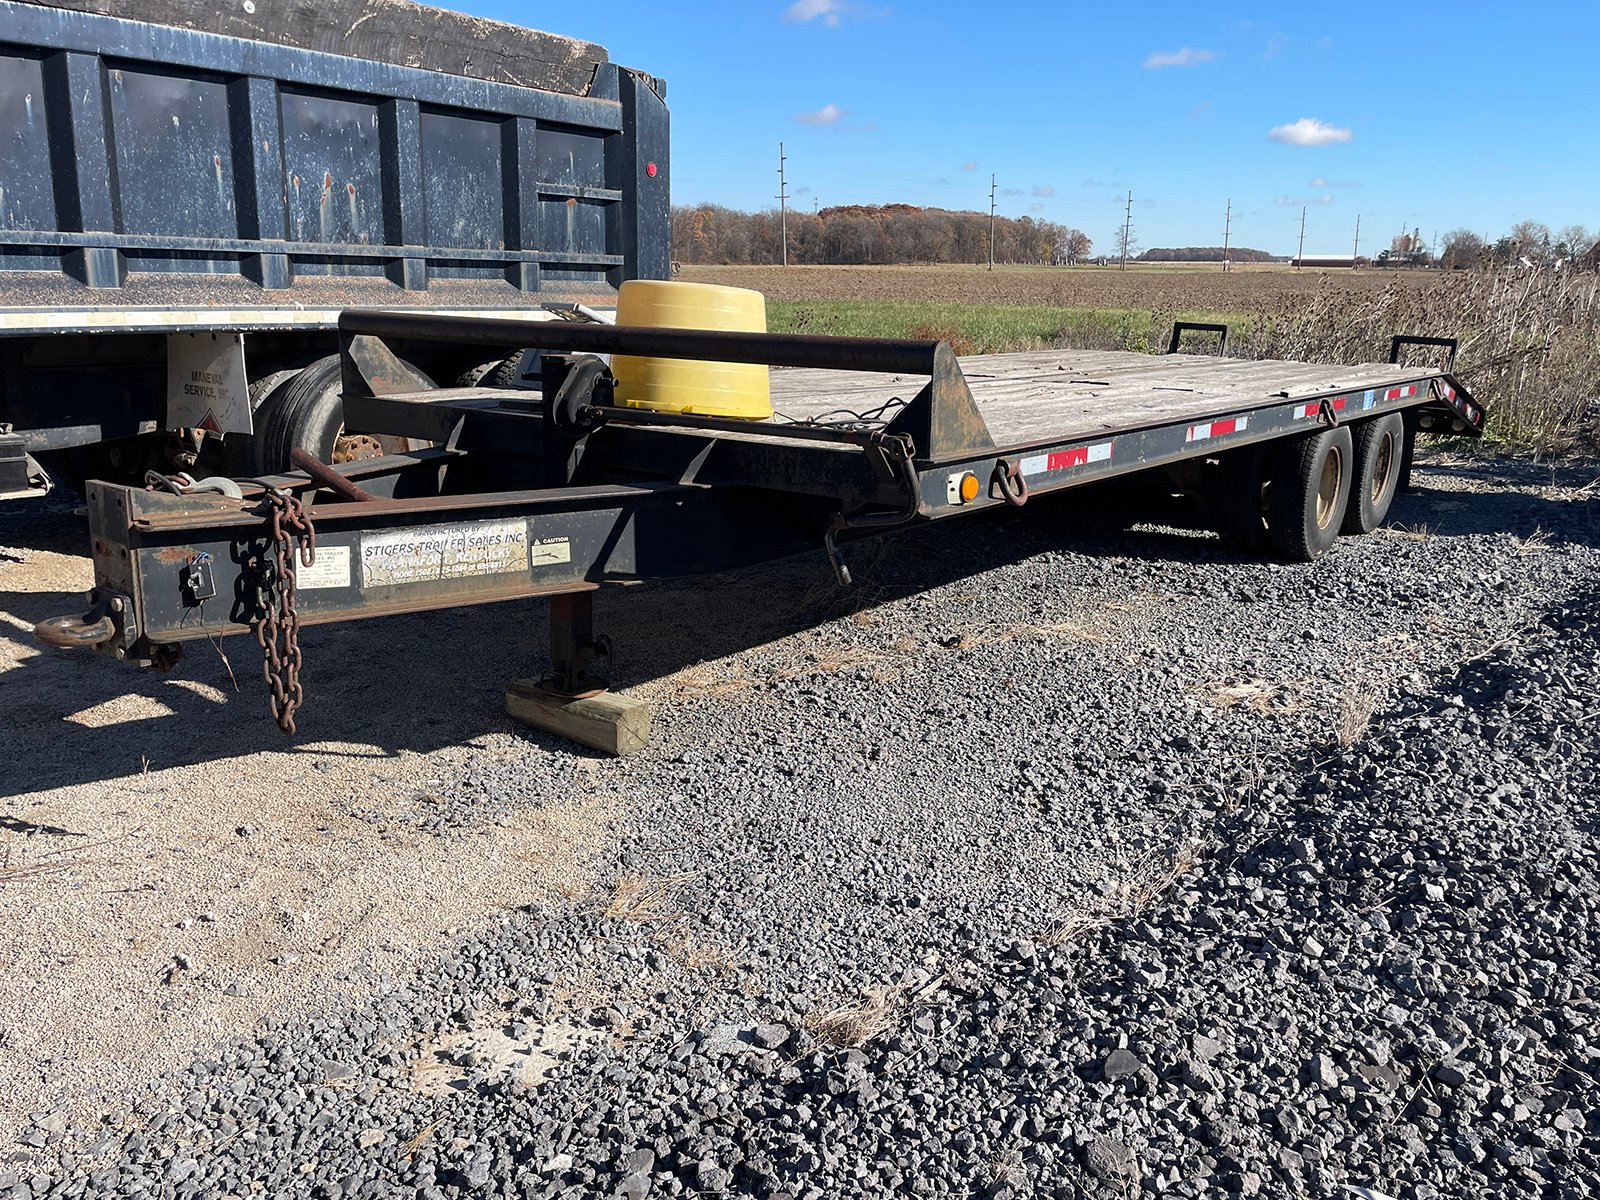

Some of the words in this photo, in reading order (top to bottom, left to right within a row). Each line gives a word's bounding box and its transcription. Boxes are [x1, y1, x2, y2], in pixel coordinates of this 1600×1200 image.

[191, 371, 224, 386] MANEVAL
[184, 384, 217, 400] SERVICE,
[413, 527, 470, 538] MANUFACTURED
[471, 525, 481, 533] BY
[365, 542, 414, 557] STIGERS
[468, 534, 502, 548] SALES
[542, 536, 569, 544] CAUTION
